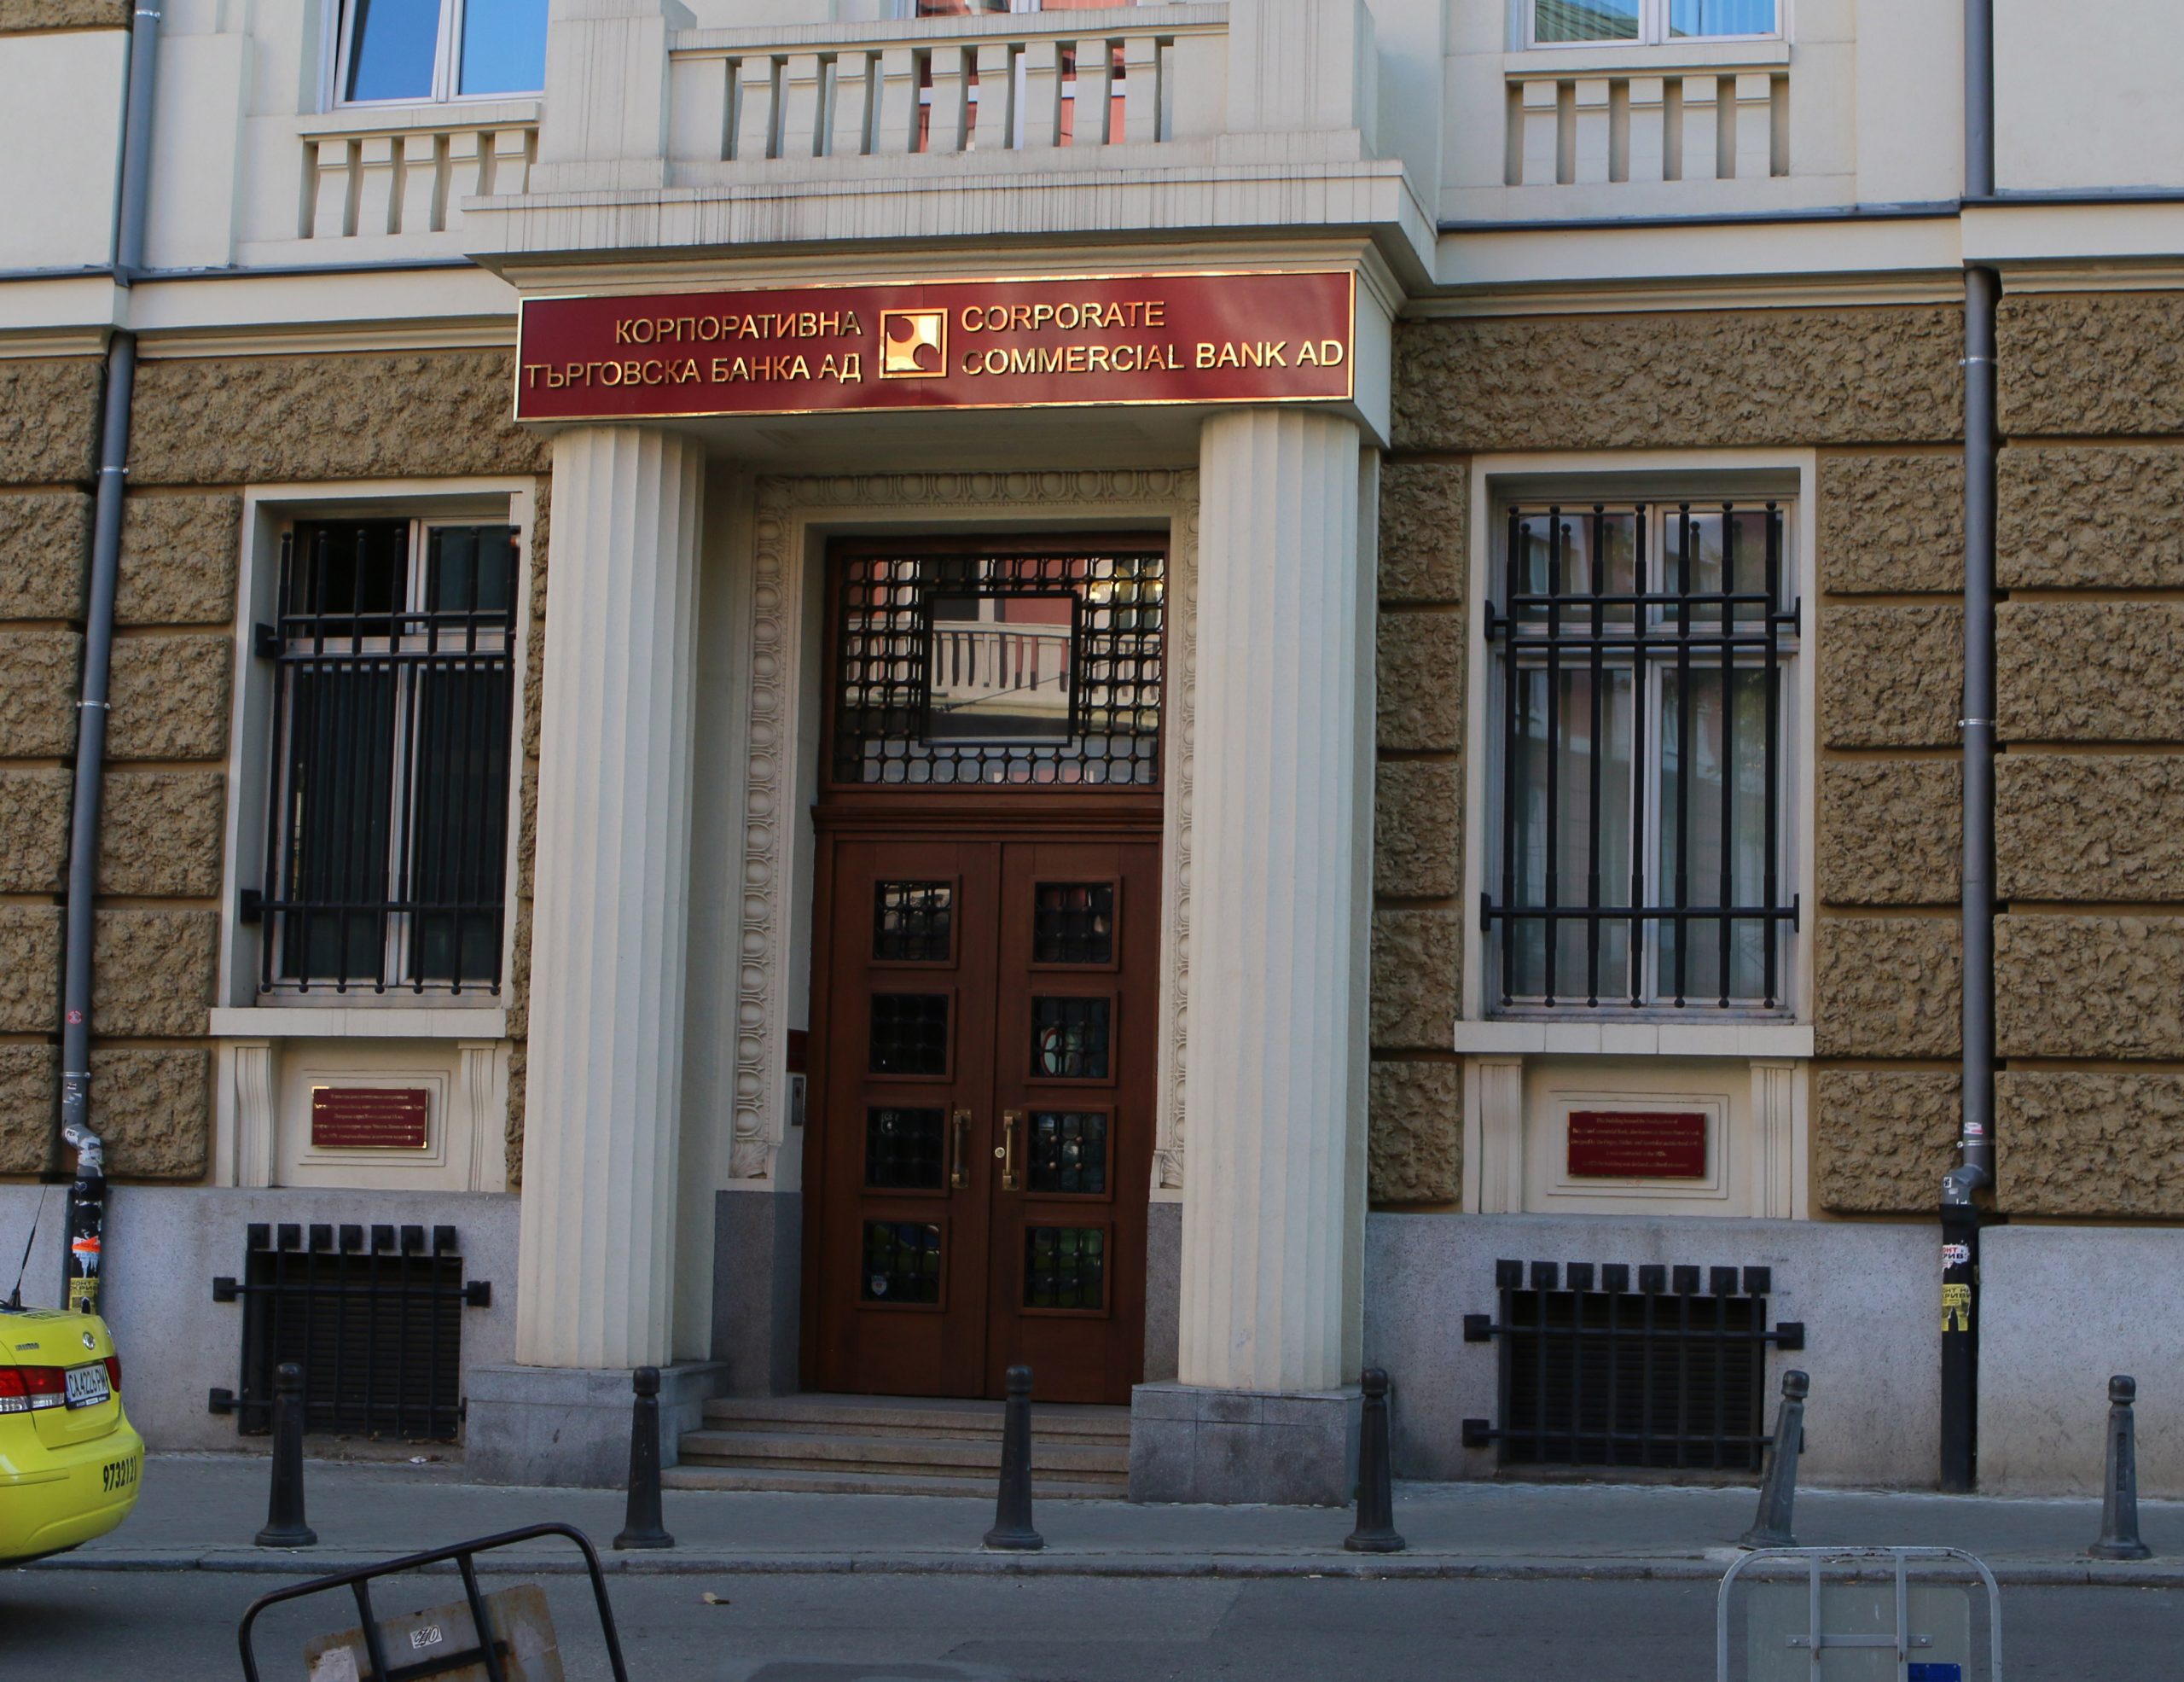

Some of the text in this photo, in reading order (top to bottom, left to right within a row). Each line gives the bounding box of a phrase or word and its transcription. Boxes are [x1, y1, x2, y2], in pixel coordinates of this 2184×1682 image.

[615, 311, 862, 344] КОРПОРАТИВНА
[961, 300, 1165, 332] CORPORATE
[524, 352, 862, 388] ТЪРГОВСКА БАНКА АД
[961, 339, 1344, 375] COMMERCIAL BANK AD
[103, 1455, 136, 1493] 9732121
